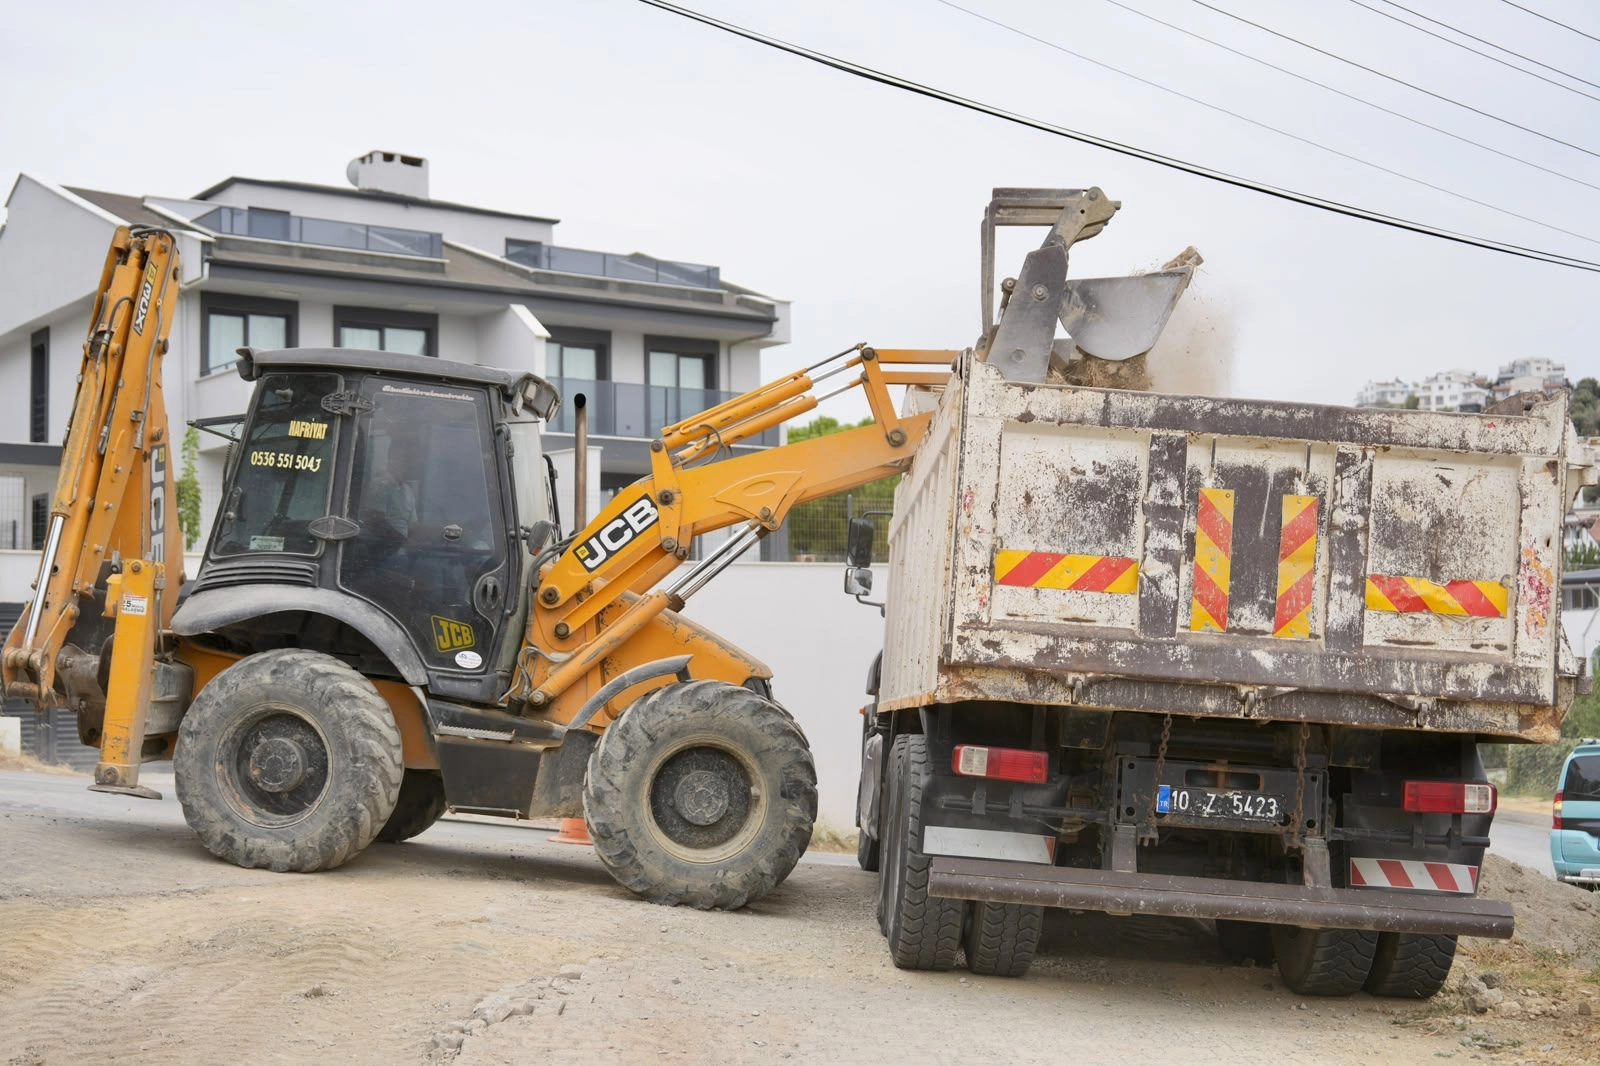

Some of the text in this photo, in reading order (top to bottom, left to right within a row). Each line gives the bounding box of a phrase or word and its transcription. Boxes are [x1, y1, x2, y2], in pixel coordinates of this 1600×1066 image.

[251, 451, 276, 467] 0536
[276, 453, 294, 469] 551
[584, 498, 659, 569] JCB
[438, 620, 473, 649] JCB
[1171, 790, 1189, 810] 10
[1232, 794, 1278, 817] 5423
